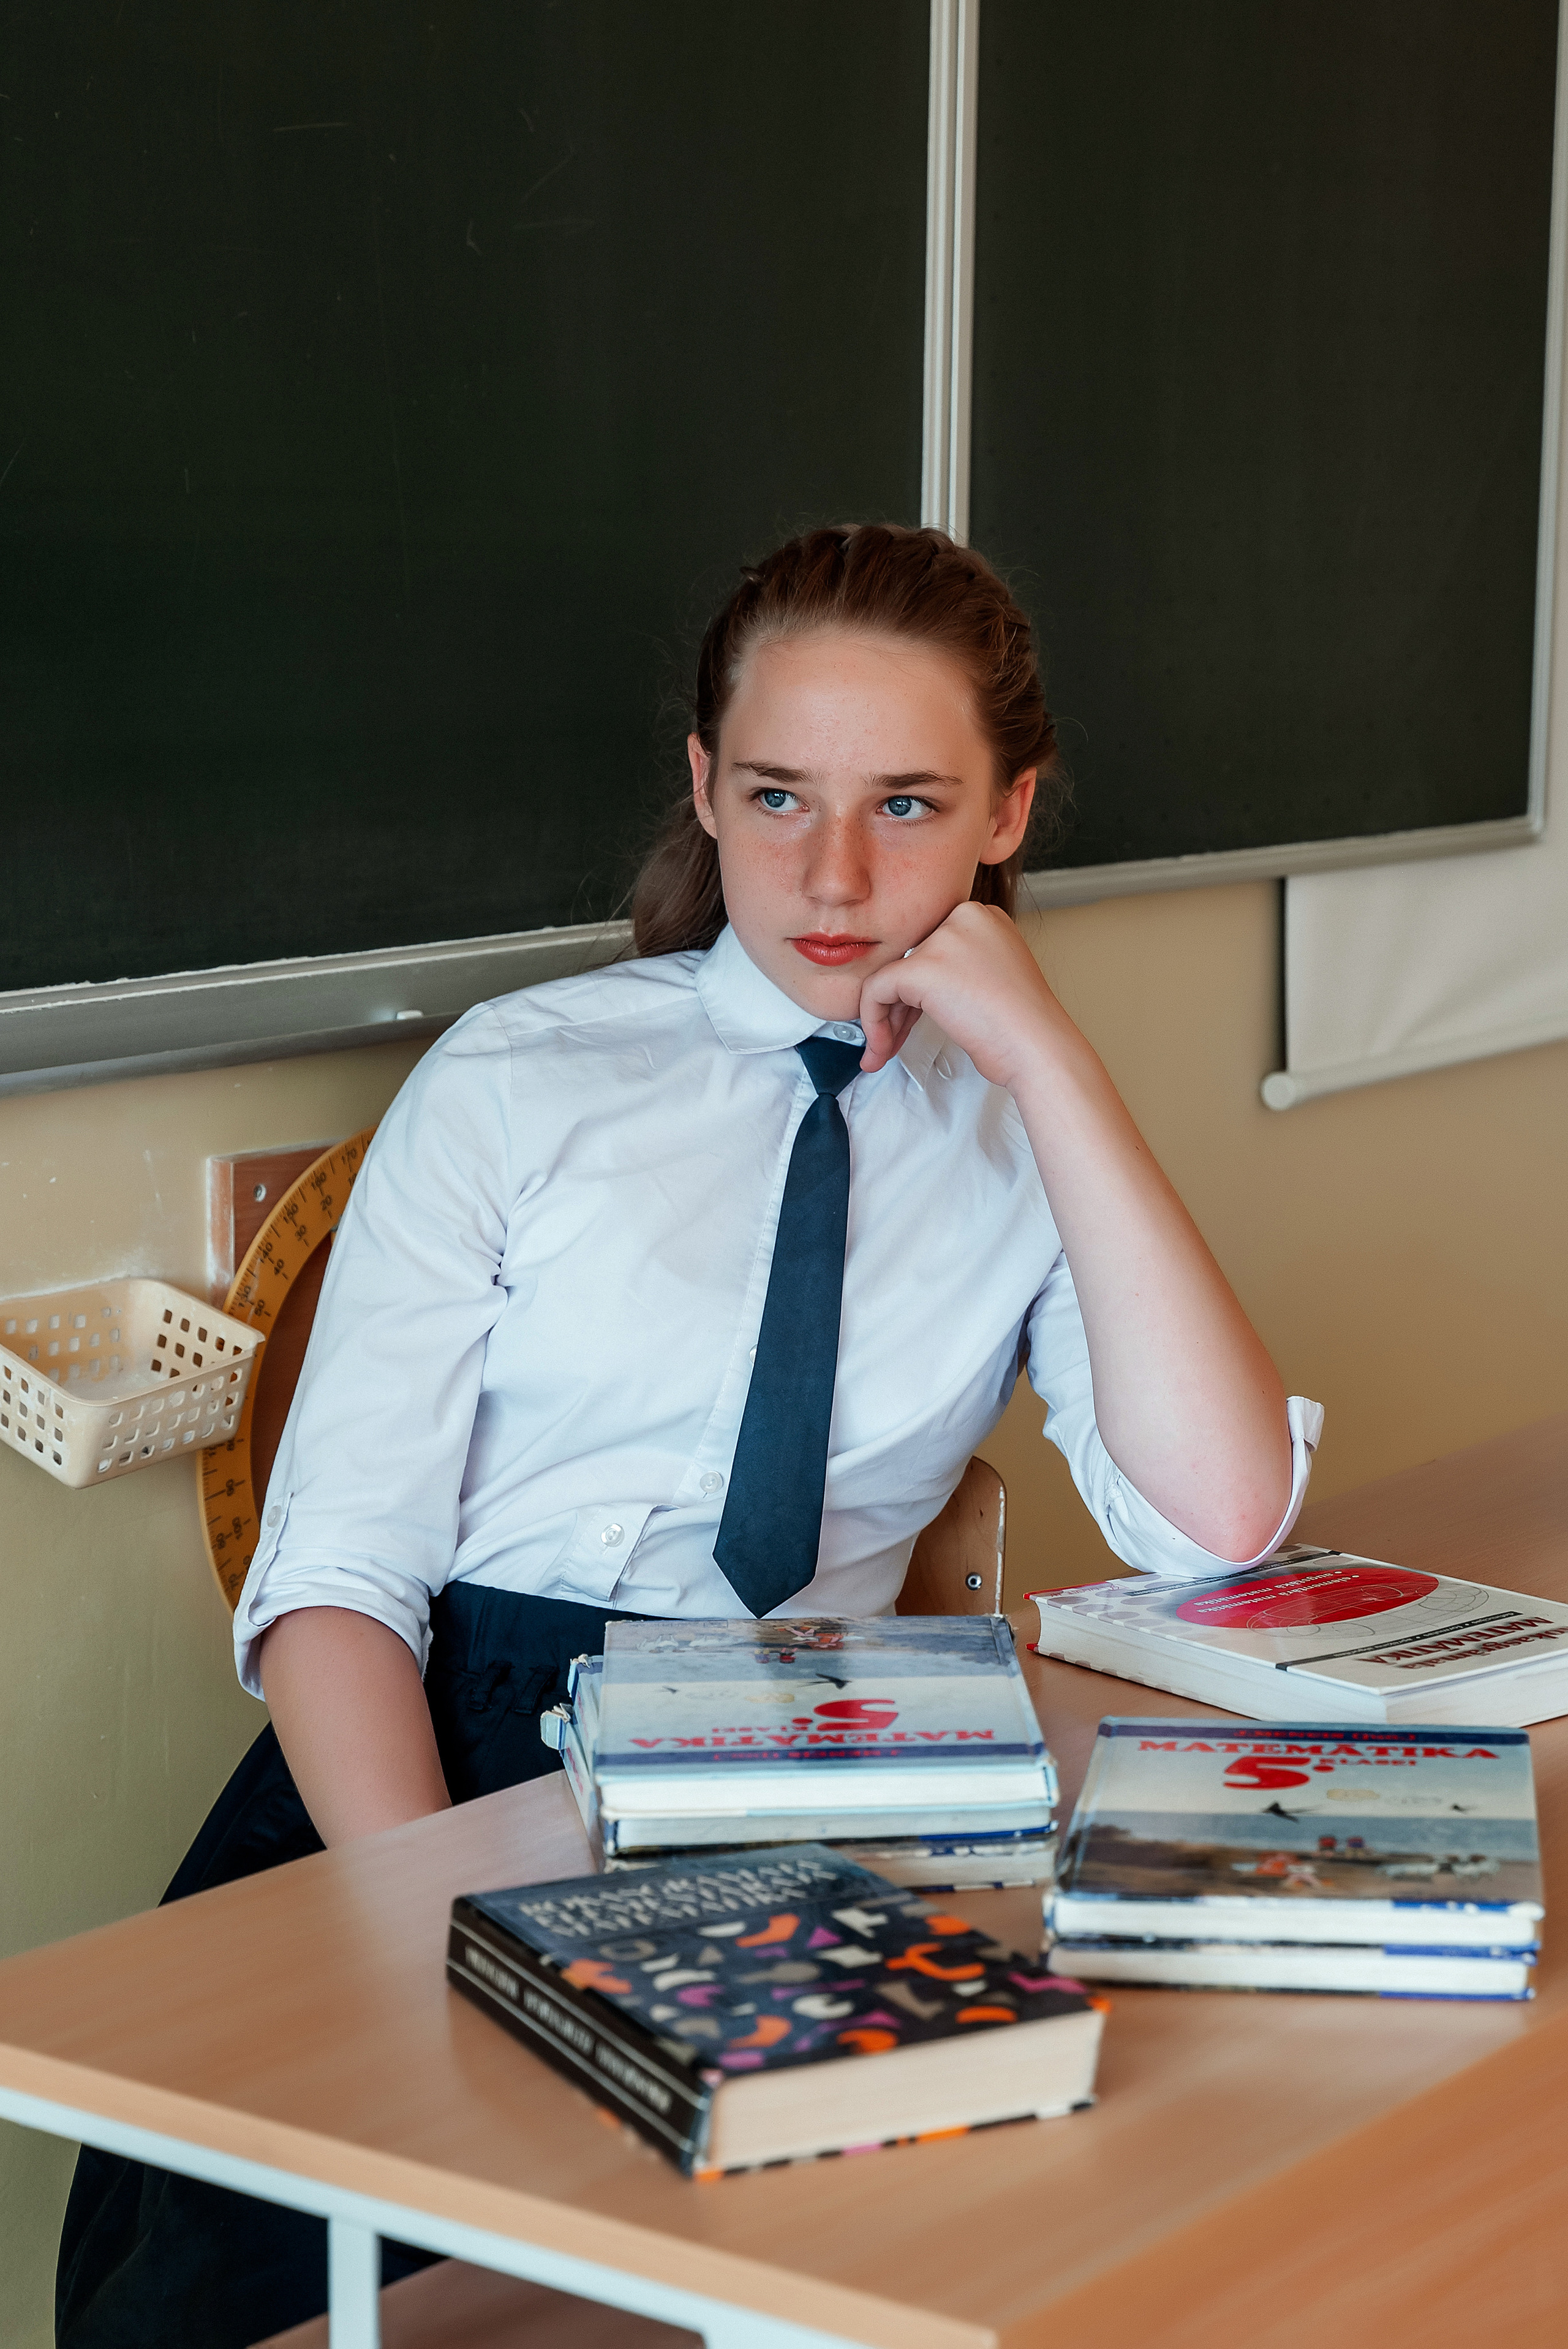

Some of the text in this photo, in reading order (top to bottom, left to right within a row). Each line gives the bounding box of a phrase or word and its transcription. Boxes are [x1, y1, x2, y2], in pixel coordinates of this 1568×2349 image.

[341, 1147, 357, 1165] 170
[311, 1171, 326, 1190] 160
[320, 1195, 333, 1211] 20
[295, 1225, 306, 1241] 30
[260, 1241, 273, 1263] 140
[274, 1258, 285, 1275] 40
[1193, 1587, 1273, 1606] matemātika
[1196, 1594, 1277, 1614] matemātika
[628, 1729, 995, 1748] MATEMĀTIKA
[1138, 1740, 1499, 1759] MATEMĀTIKA
